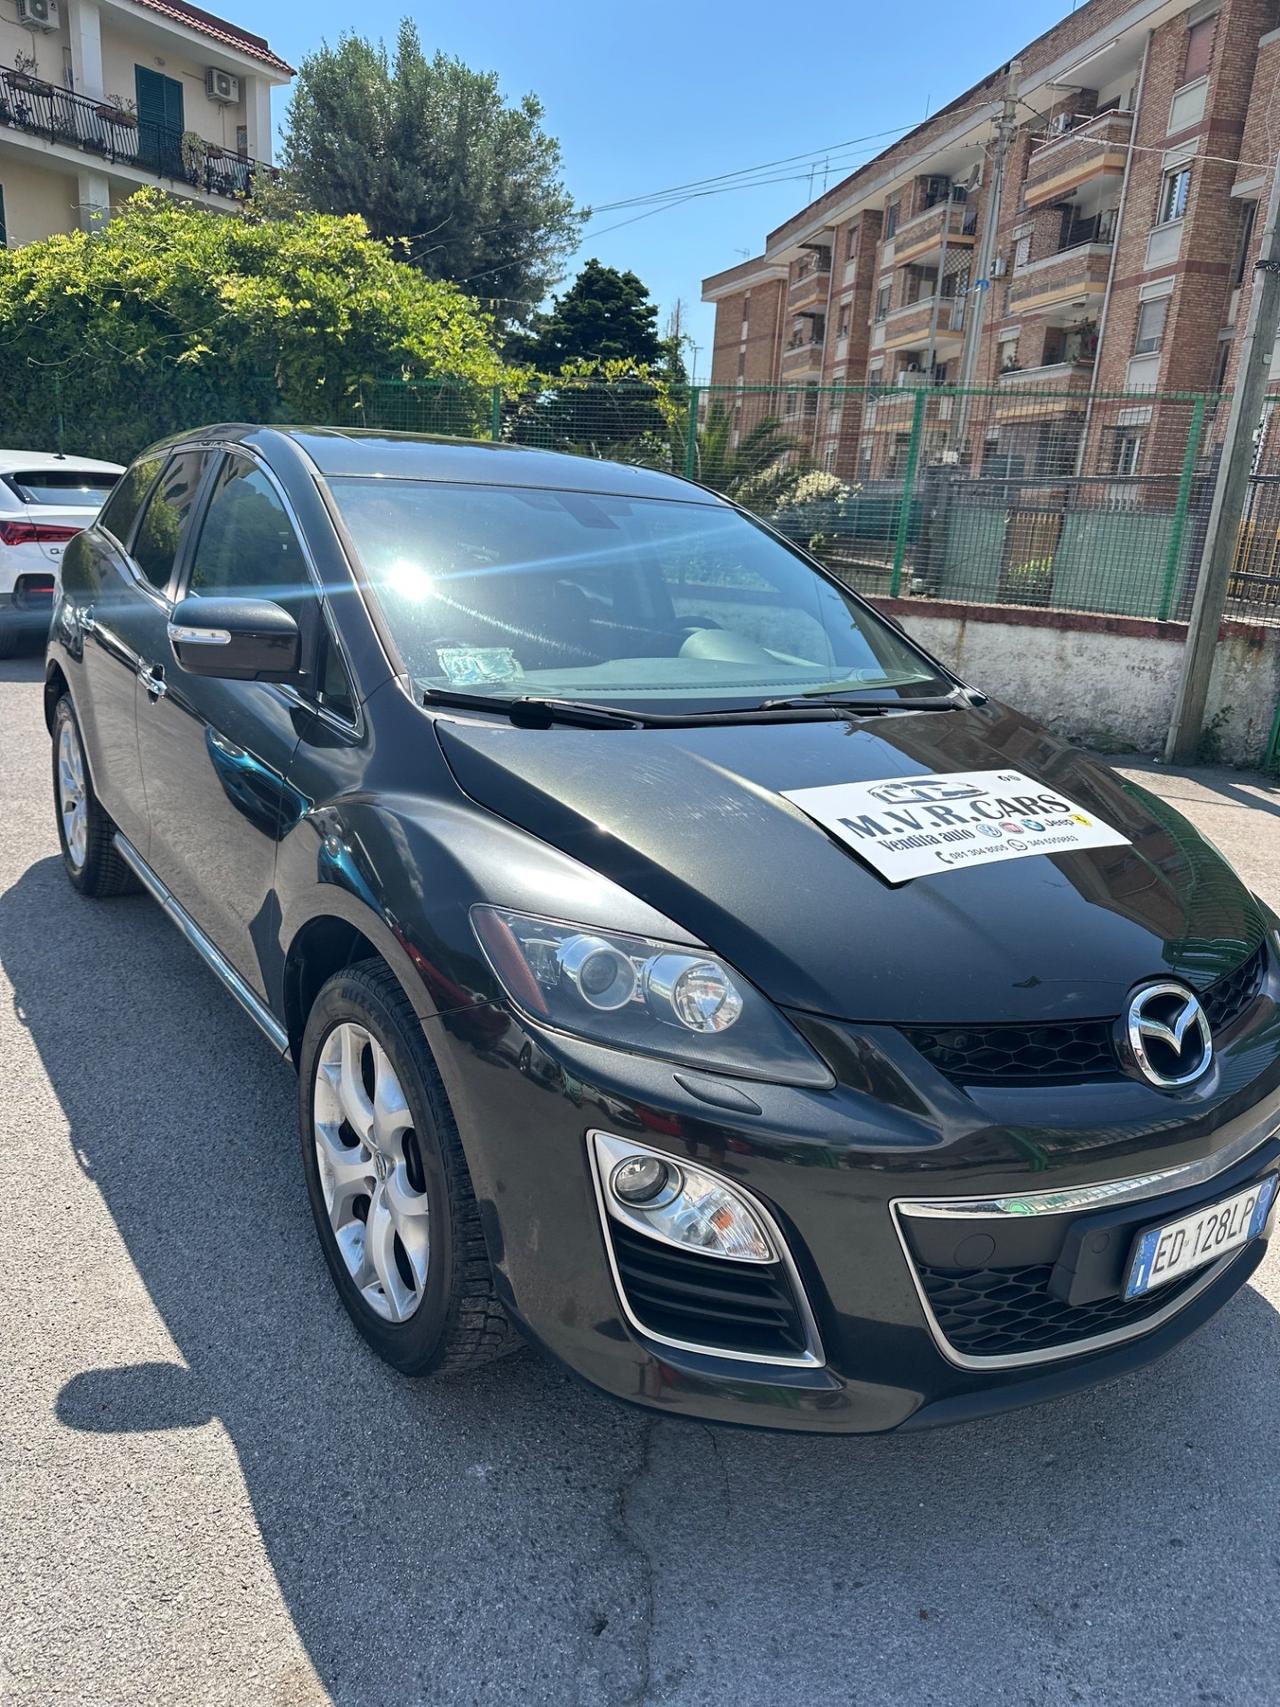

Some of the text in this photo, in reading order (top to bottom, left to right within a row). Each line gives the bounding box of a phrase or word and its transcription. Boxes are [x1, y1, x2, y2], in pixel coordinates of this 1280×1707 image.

[836, 794, 1070, 839] M.V.R.CARS
[1044, 819, 1075, 827] Jeep
[877, 834, 942, 852] Vendita
[938, 829, 976, 843] auto
[949, 851, 968, 860] 081
[1152, 1229, 1186, 1275] ED
[1192, 1196, 1256, 1257] 128LP
